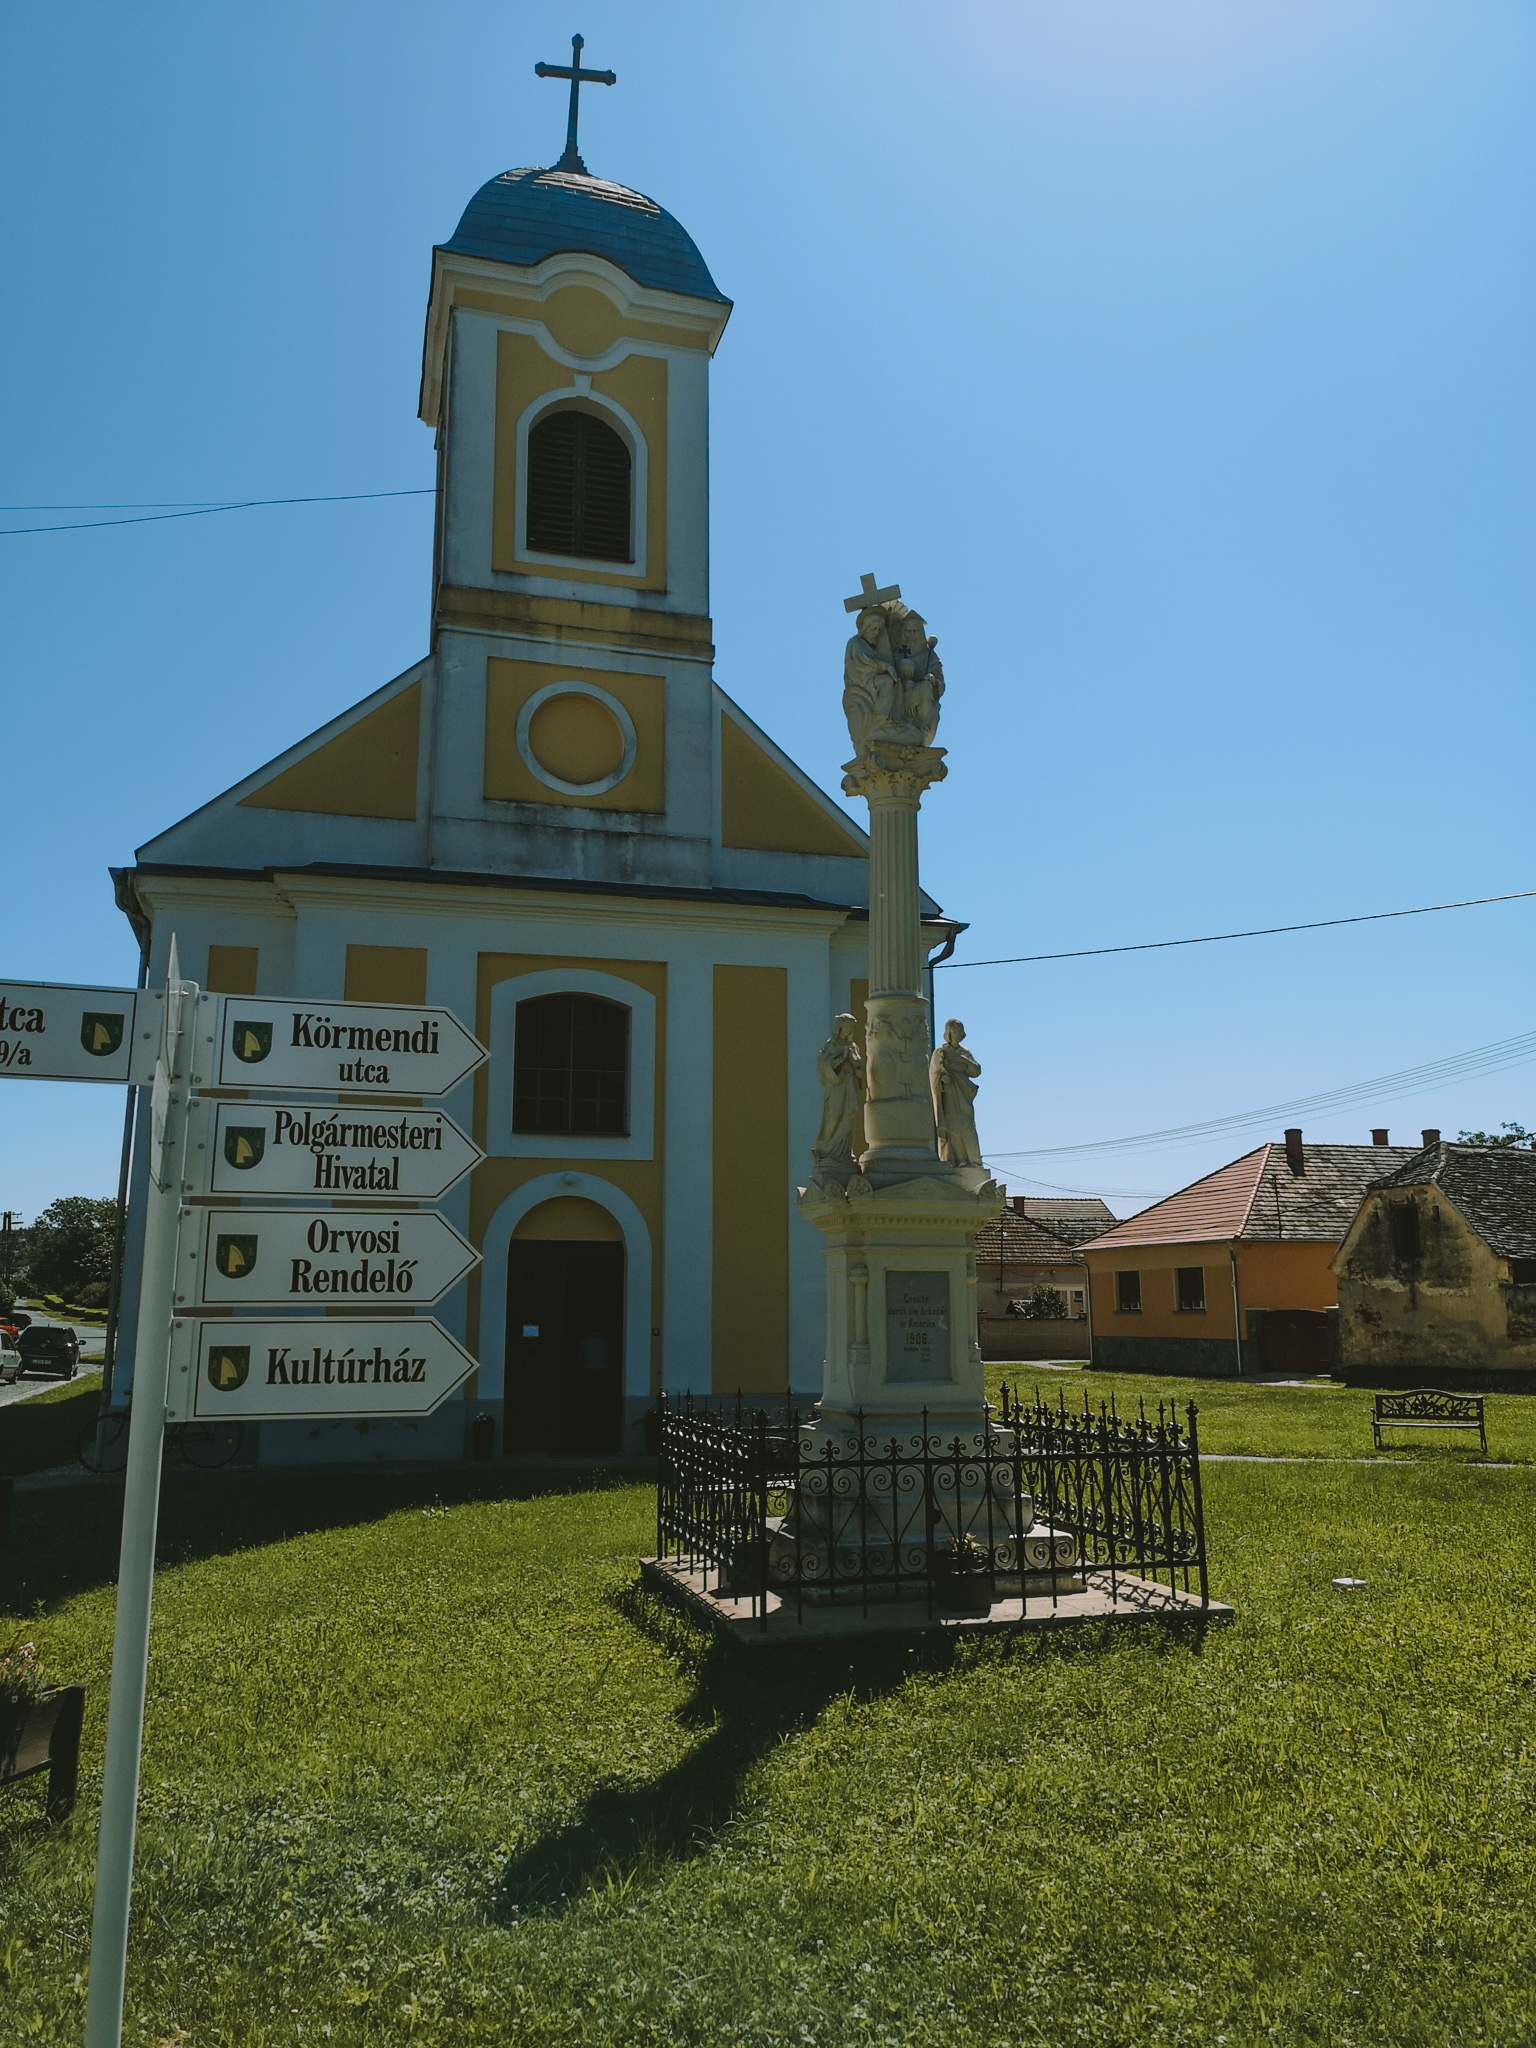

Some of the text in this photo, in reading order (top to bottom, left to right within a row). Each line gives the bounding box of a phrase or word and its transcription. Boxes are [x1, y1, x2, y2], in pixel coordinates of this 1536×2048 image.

[290, 1013, 440, 1055] Körmendi
[338, 1056, 390, 1084] utca
[272, 1110, 443, 1155] Polgármesteri
[313, 1154, 400, 1191] Hivatal
[307, 1218, 400, 1254] Orvosi
[288, 1258, 419, 1294] Rendelő
[265, 1346, 427, 1386] Kultúrház
